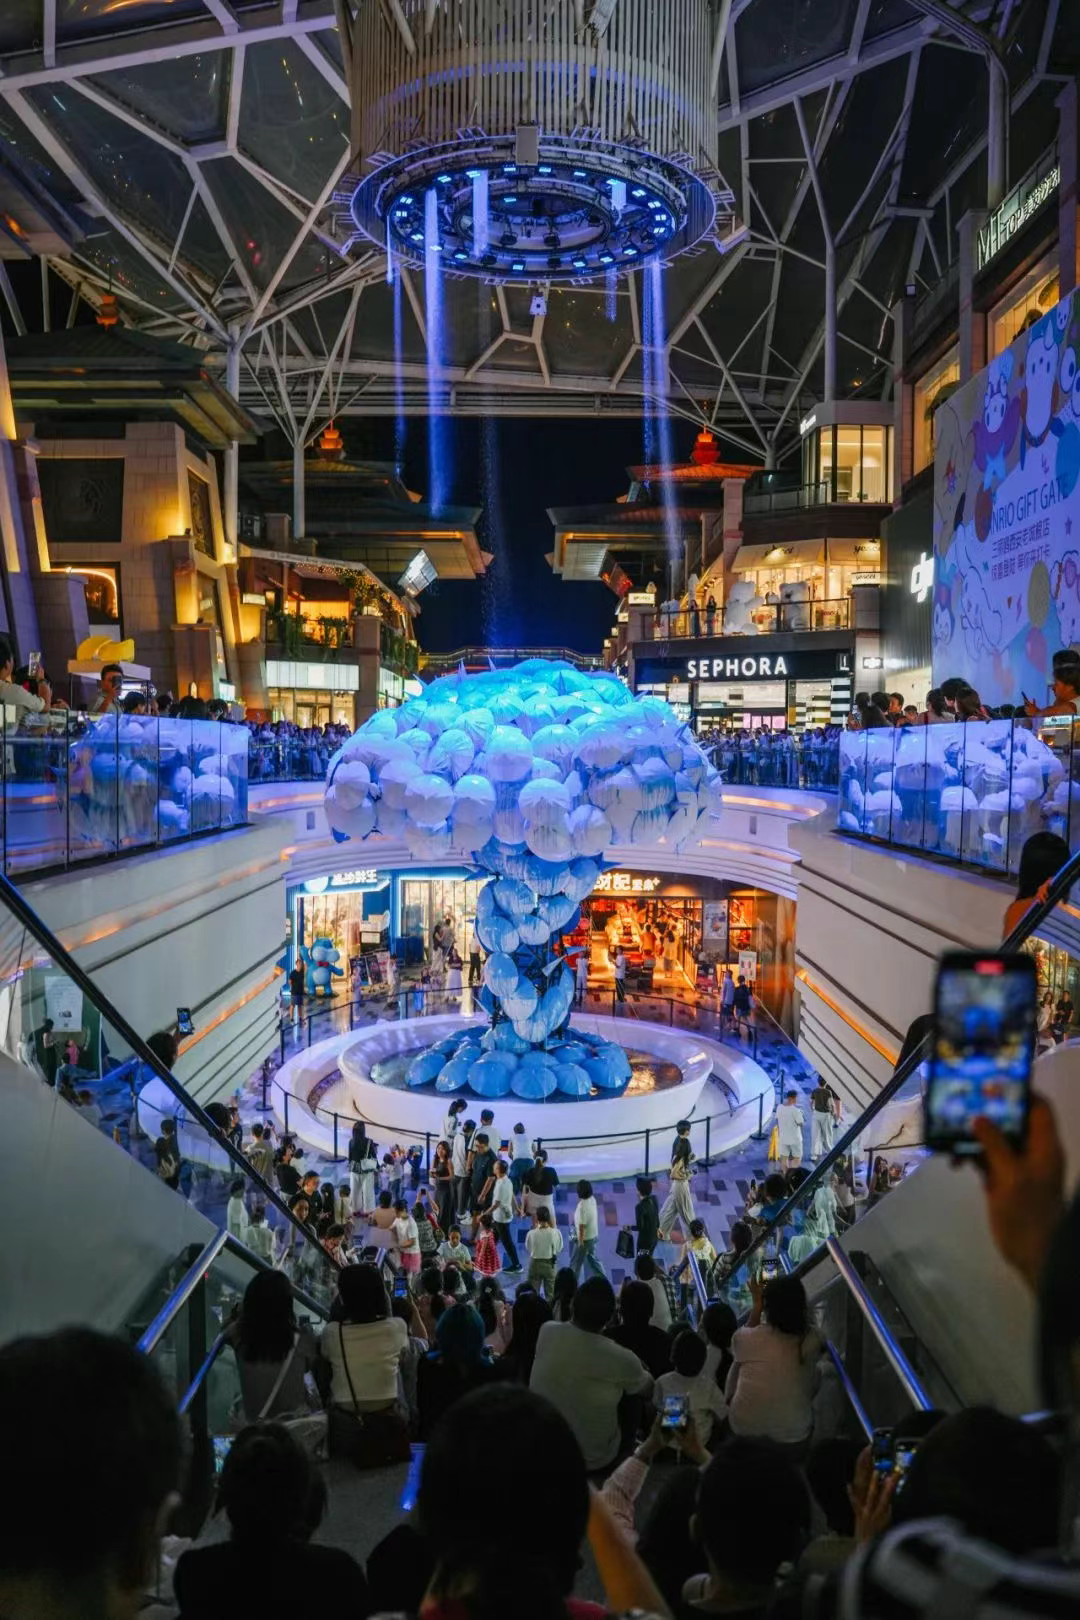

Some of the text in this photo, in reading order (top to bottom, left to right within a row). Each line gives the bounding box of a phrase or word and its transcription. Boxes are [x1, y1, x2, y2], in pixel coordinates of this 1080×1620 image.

[990, 502, 1015, 535] NRIO
[1016, 487, 1039, 522] GIFT
[686, 656, 788, 679] SEPHORA
